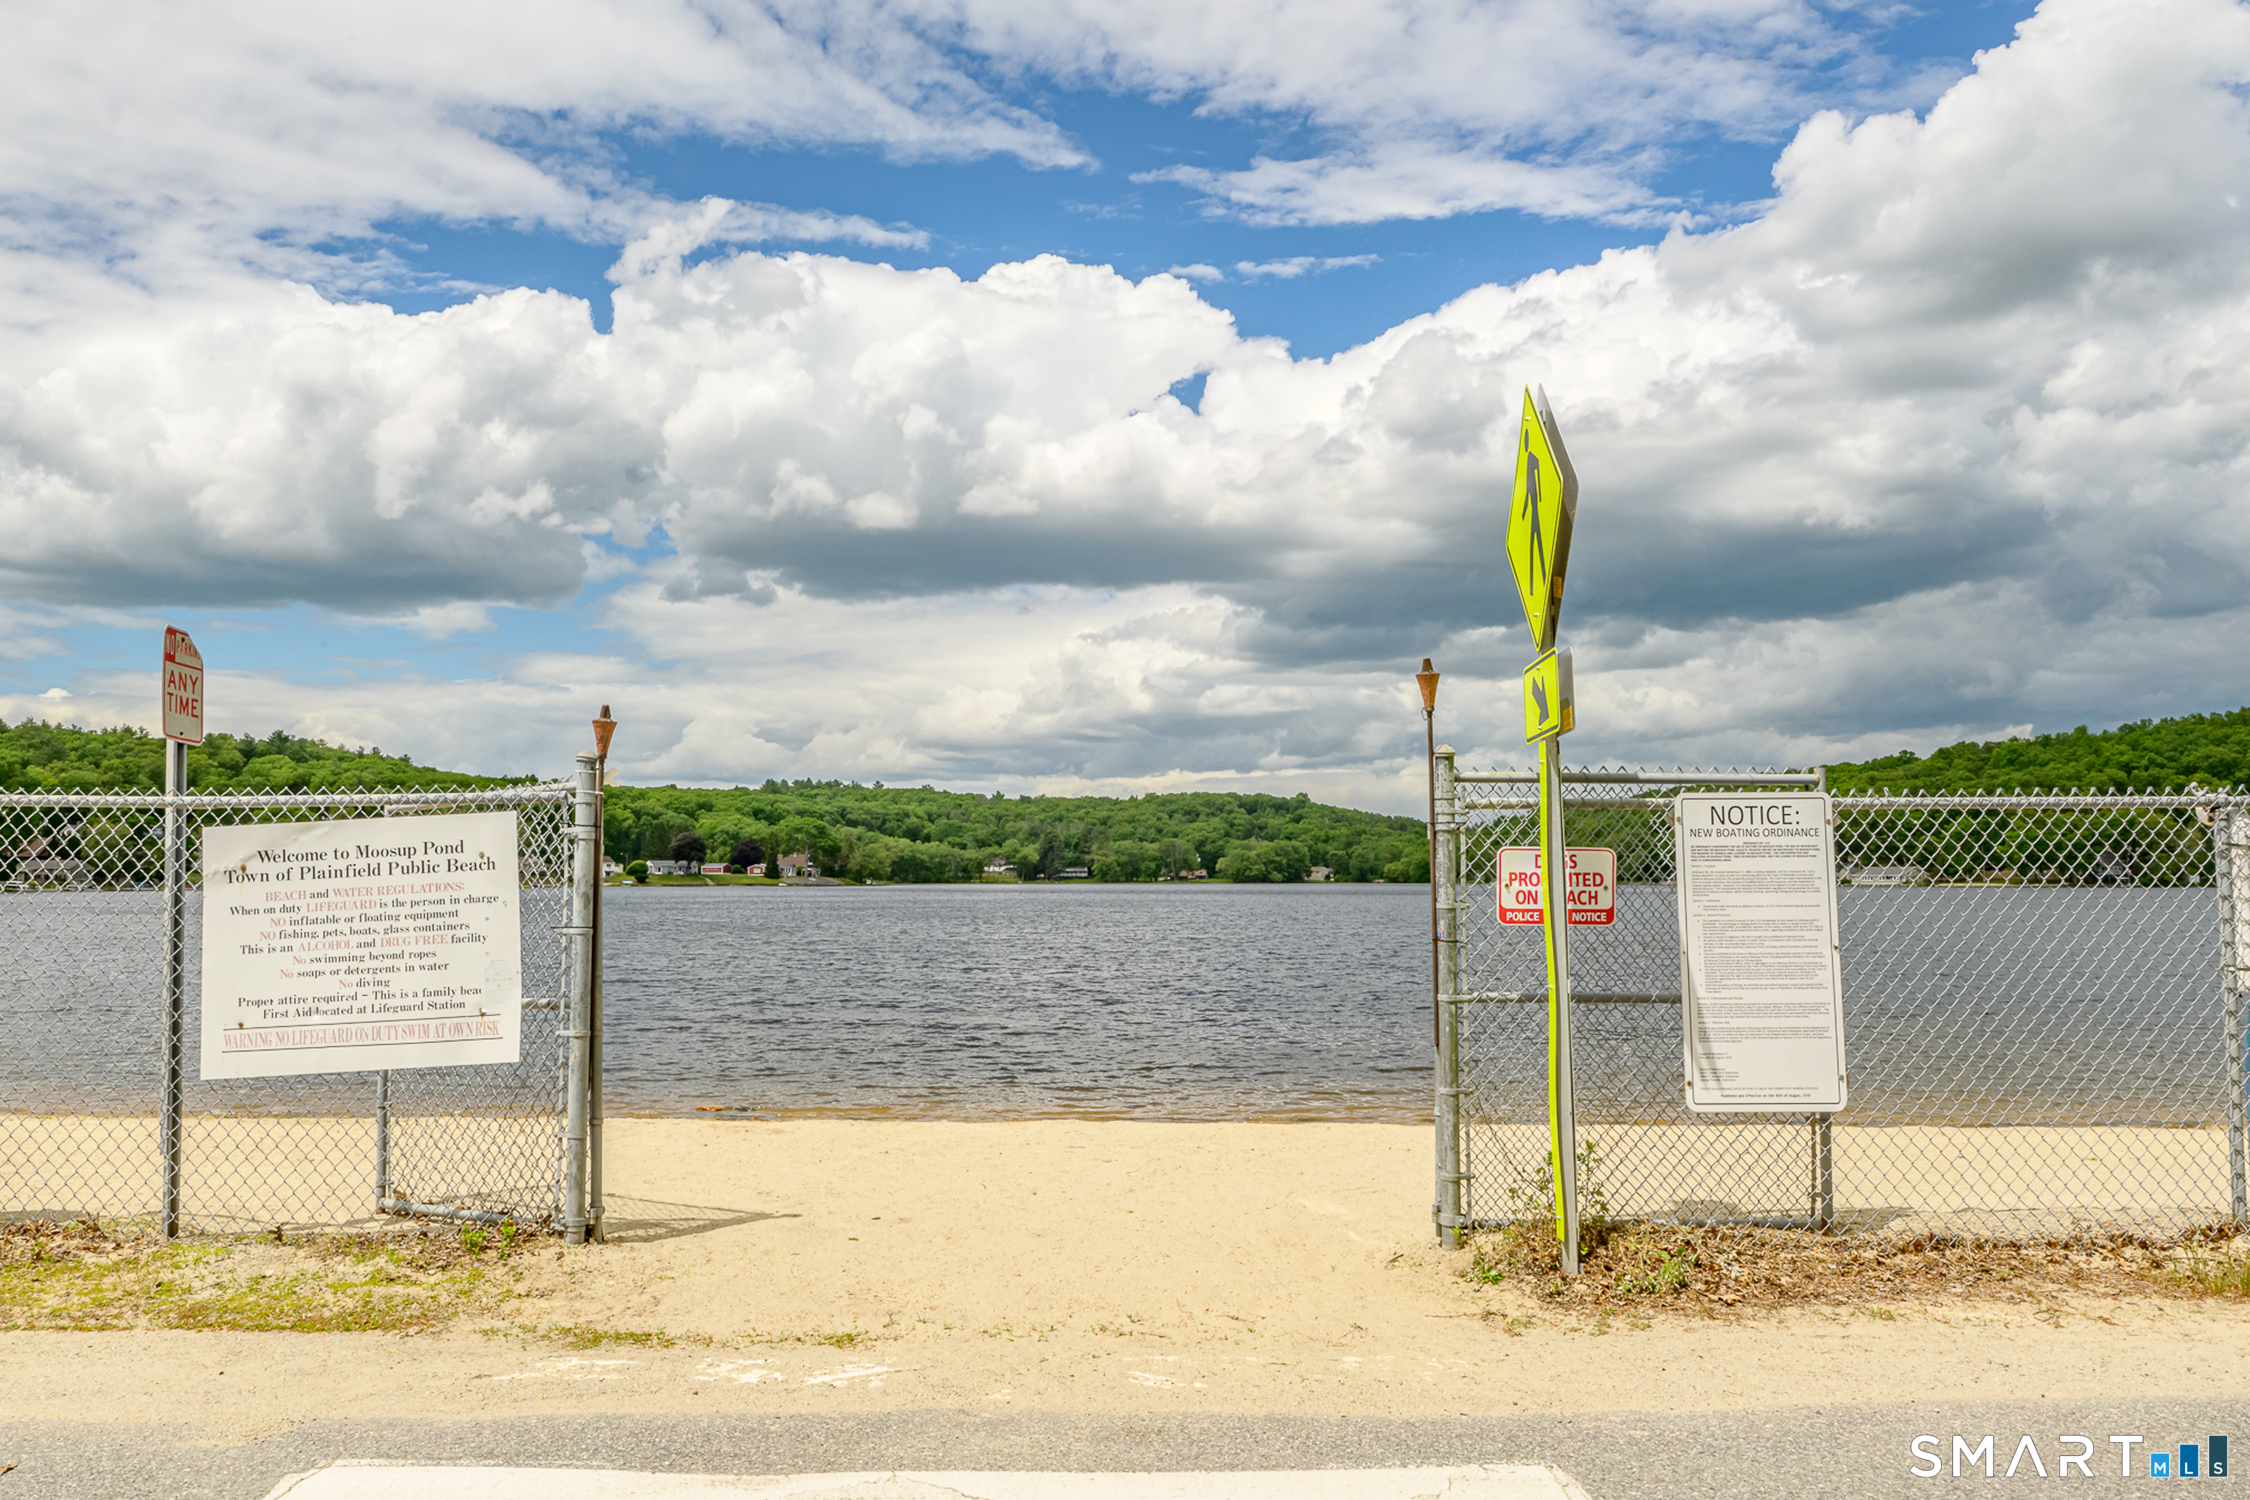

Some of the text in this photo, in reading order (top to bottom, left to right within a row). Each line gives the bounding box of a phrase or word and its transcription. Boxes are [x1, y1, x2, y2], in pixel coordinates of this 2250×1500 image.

[166, 633, 174, 655] NO
[168, 670, 198, 694] ANY
[167, 692, 199, 718] TIME
[1710, 804, 1800, 826] NOTICE:
[1690, 828, 1820, 838] NEW BOATING ORDINANCE
[257, 840, 464, 863] Welcome to Moosup Pond
[224, 857, 496, 884] Town of Plainfield Public Beach
[265, 882, 465, 902] BEACH and WATER REGULATIONS:
[1515, 890, 1538, 905] ON
[230, 894, 499, 916] When on duty LIFEGUARD is the person in charge
[270, 918, 286, 928] NO
[289, 915, 341, 926] inflatable
[359, 912, 400, 922] floating
[404, 909, 459, 921] equipment
[1506, 912, 1607, 922] POLICE NOTICE
[260, 931, 276, 941] NO
[383, 925, 410, 935] glass
[413, 922, 470, 932] containers
[240, 944, 264, 955] This
[268, 944, 276, 954] is
[298, 940, 354, 952] ALCOHOL
[356, 938, 376, 948] and
[380, 937, 411, 947] DRUG
[415, 934, 448, 946] FREE
[451, 933, 488, 944] facility
[292, 950, 437, 965] No swimming beyond ropes
[280, 962, 449, 979] No soaps or detergents in water
[339, 978, 391, 989] No diving
[238, 997, 273, 1008] Proper
[278, 995, 308, 1005] attire
[312, 992, 358, 1004] required
[372, 990, 396, 1000] This
[400, 989, 409, 999] is
[422, 987, 456, 998] family
[263, 999, 466, 1019] First Aid located at Lifeguard Station
[224, 1020, 500, 1049] WARNING NO LIFEGUARD ON DUTY SWIM AT OWN RISK
